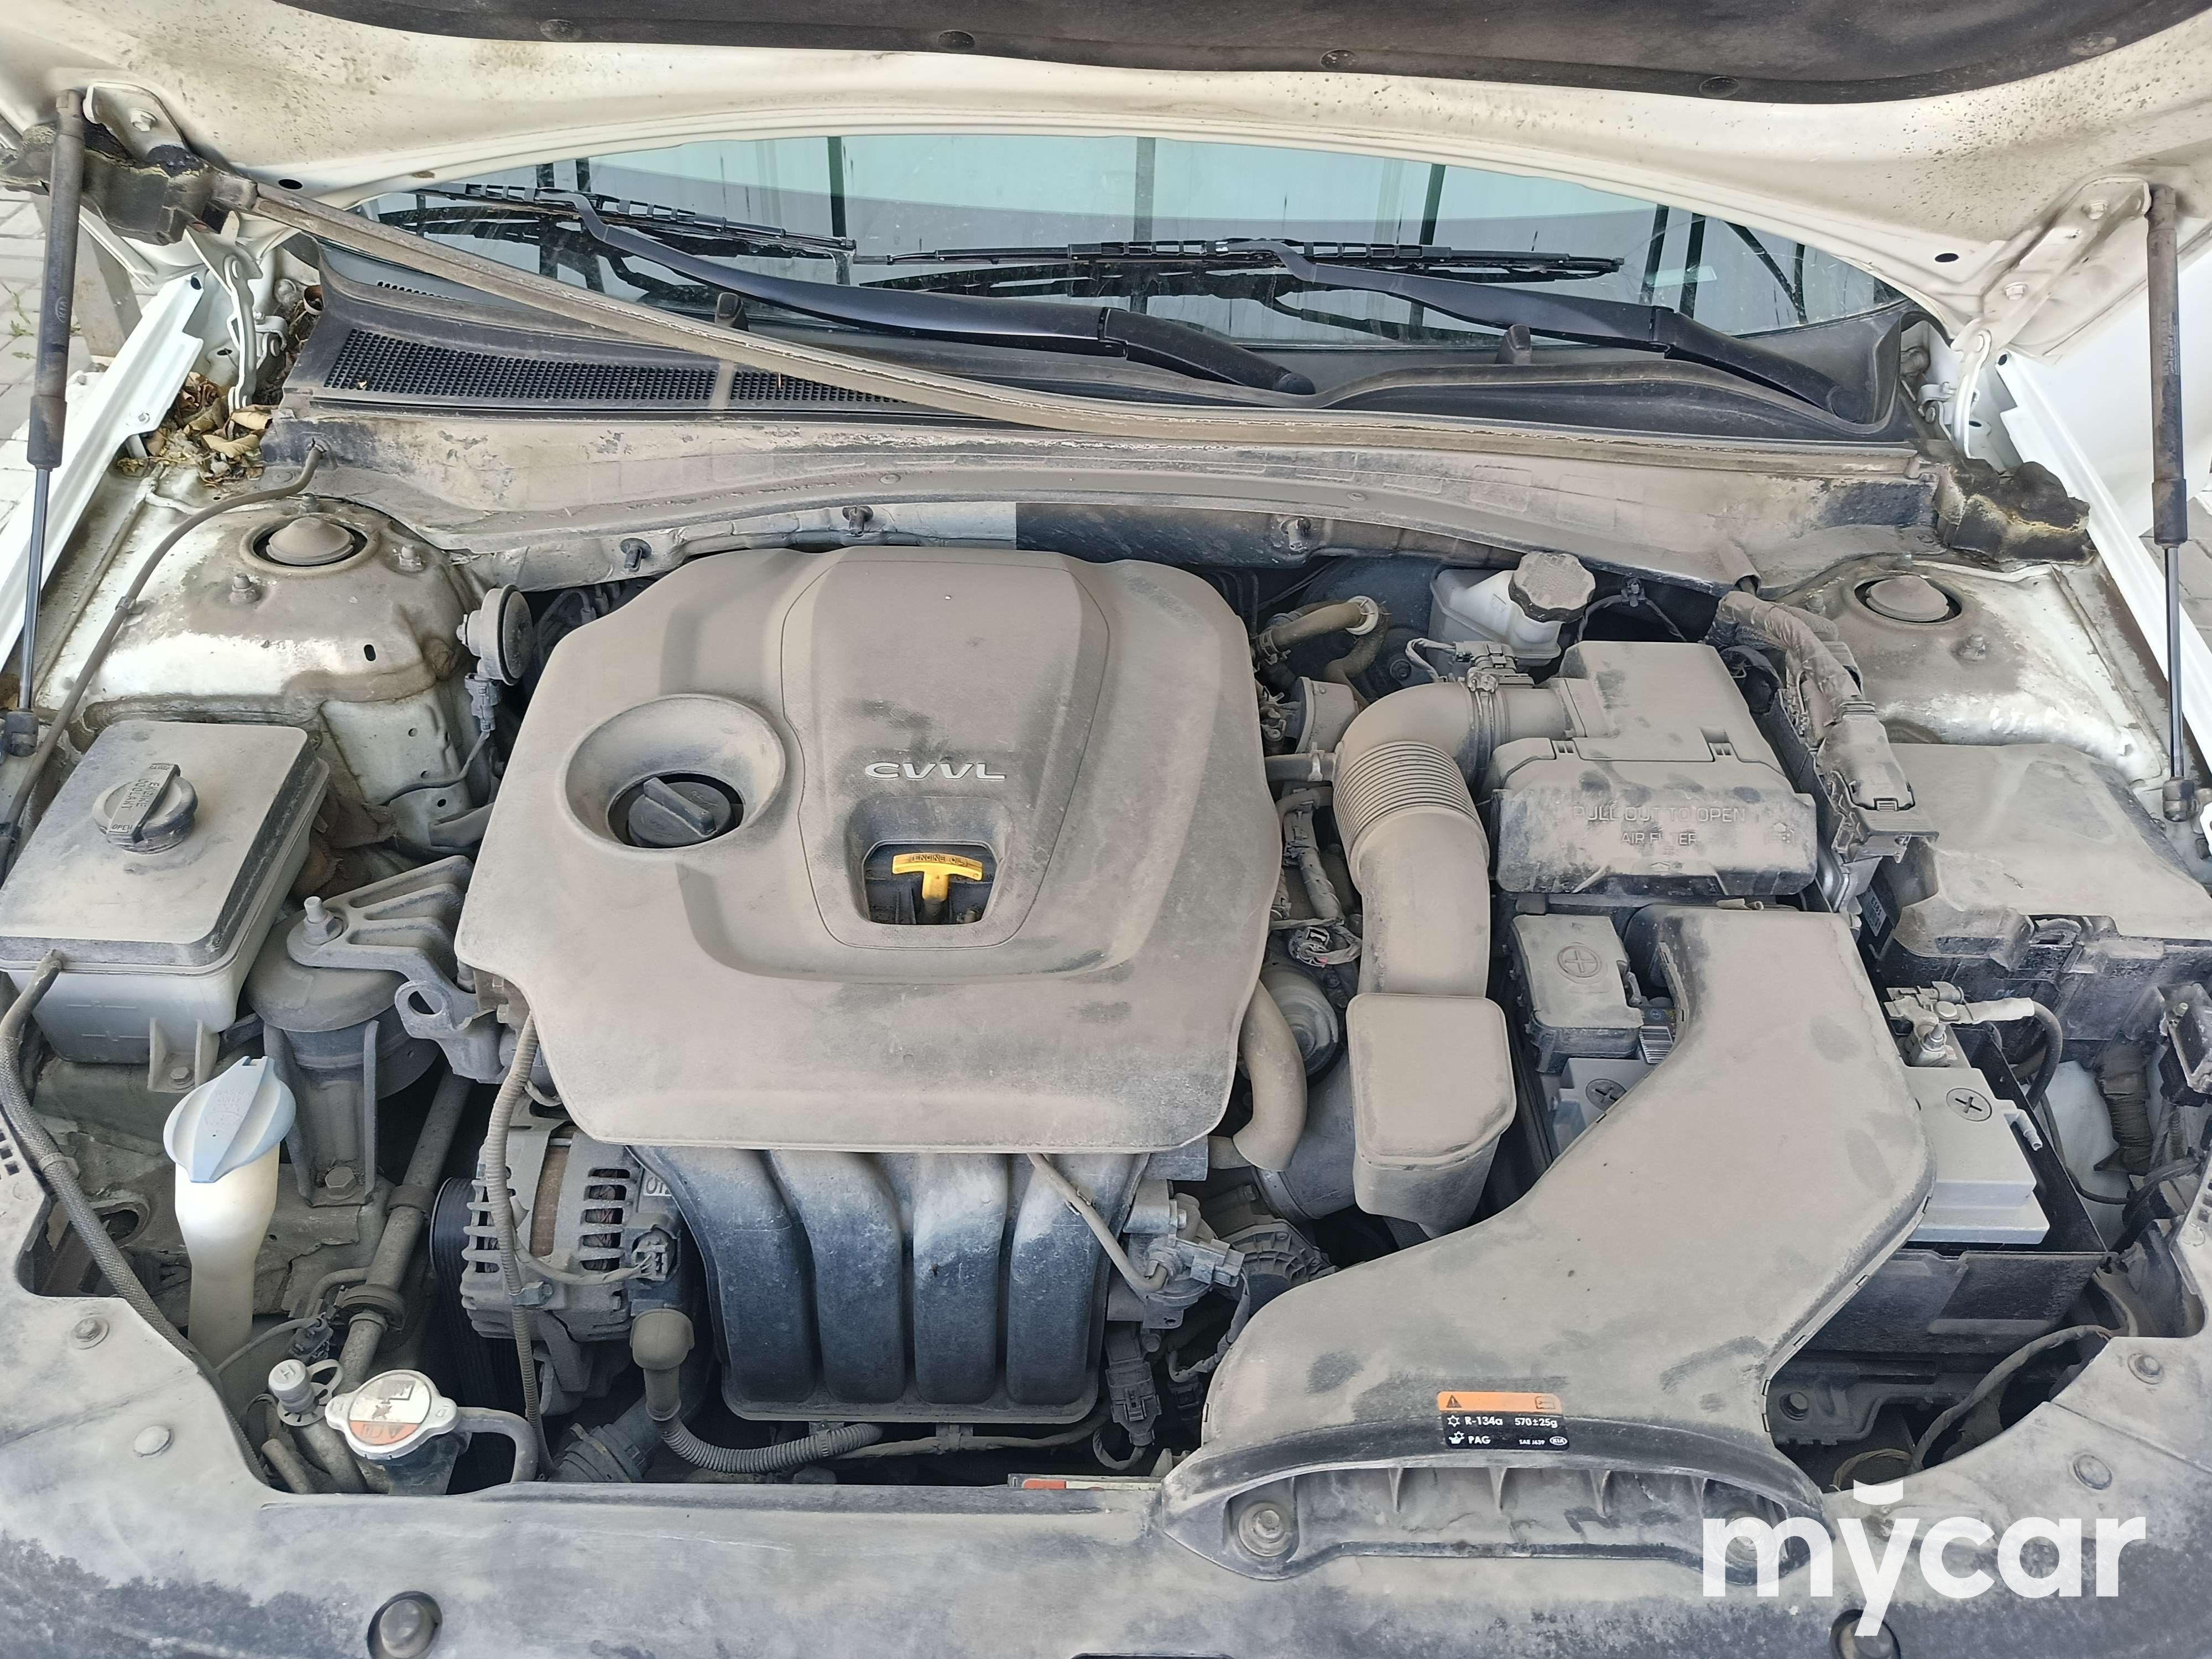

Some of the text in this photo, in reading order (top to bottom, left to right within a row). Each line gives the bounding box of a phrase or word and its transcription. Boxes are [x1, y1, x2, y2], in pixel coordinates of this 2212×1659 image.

[865, 762, 1006, 780] CVVL
[121, 779, 149, 810] COOLANT
[1573, 806, 1746, 822] PULL OUT TO OPEN
[1621, 832, 1697, 845] AIR FITER
[914, 854, 946, 862] ENGINE
[1465, 1416, 1558, 1428] R-134a 570±25g
[1468, 1436, 1491, 1444] PAG
